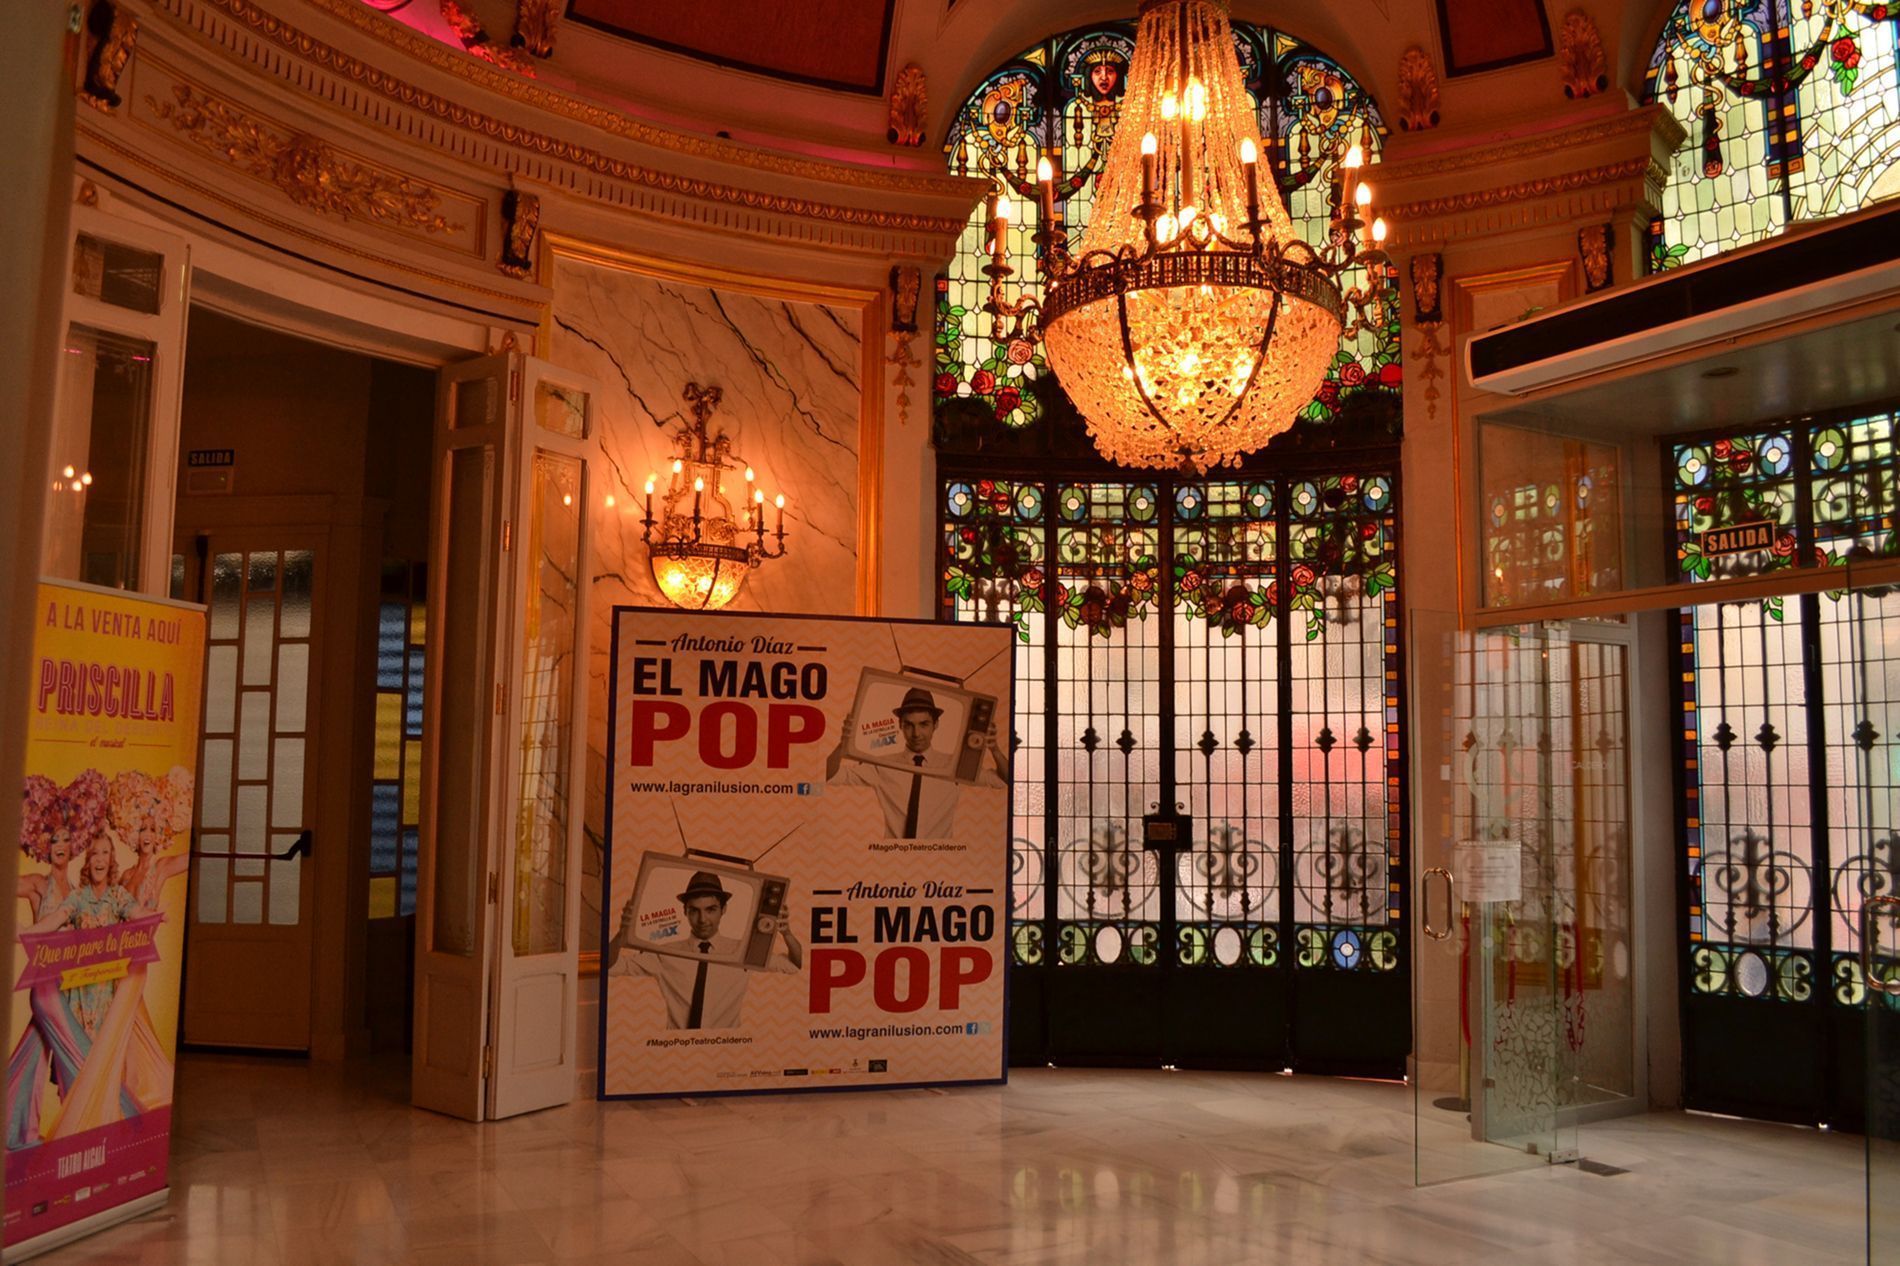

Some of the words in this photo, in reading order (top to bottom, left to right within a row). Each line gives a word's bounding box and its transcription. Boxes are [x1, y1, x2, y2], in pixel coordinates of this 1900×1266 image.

[191, 452, 231, 465] SALIDA
[1707, 527, 1769, 552] SALIDA
[46, 602, 57, 628] A
[63, 604, 84, 632] LA
[92, 609, 141, 640] VENTA
[146, 618, 182, 646] AQUÍ
[670, 632, 746, 655] Antonio
[750, 636, 795, 656] Díaz
[38, 656, 175, 722] PRISCILLA
[633, 657, 683, 697] EL
[698, 659, 828, 701] MAGO
[630, 700, 827, 770] POP
[861, 722, 871, 731] LA
[871, 718, 895, 729] MAGIA
[630, 780, 794, 797] www.lagranilusion.com
[846, 881, 917, 900] Antonio
[918, 879, 964, 899] Díaz
[640, 913, 650, 922] LA
[651, 907, 676, 919] MAGIA
[810, 905, 858, 944] EL
[874, 904, 995, 943] MAGO
[33, 943, 61, 968] ¡Que
[63, 946, 77, 961] no
[78, 940, 104, 964] pare
[105, 934, 117, 953] la
[118, 926, 155, 956] fiesta!
[808, 945, 993, 1014] POP
[646, 1035, 753, 1047] #MagoPopTeatroCalderon
[808, 1023, 964, 1040] www.lagranilusion.com
